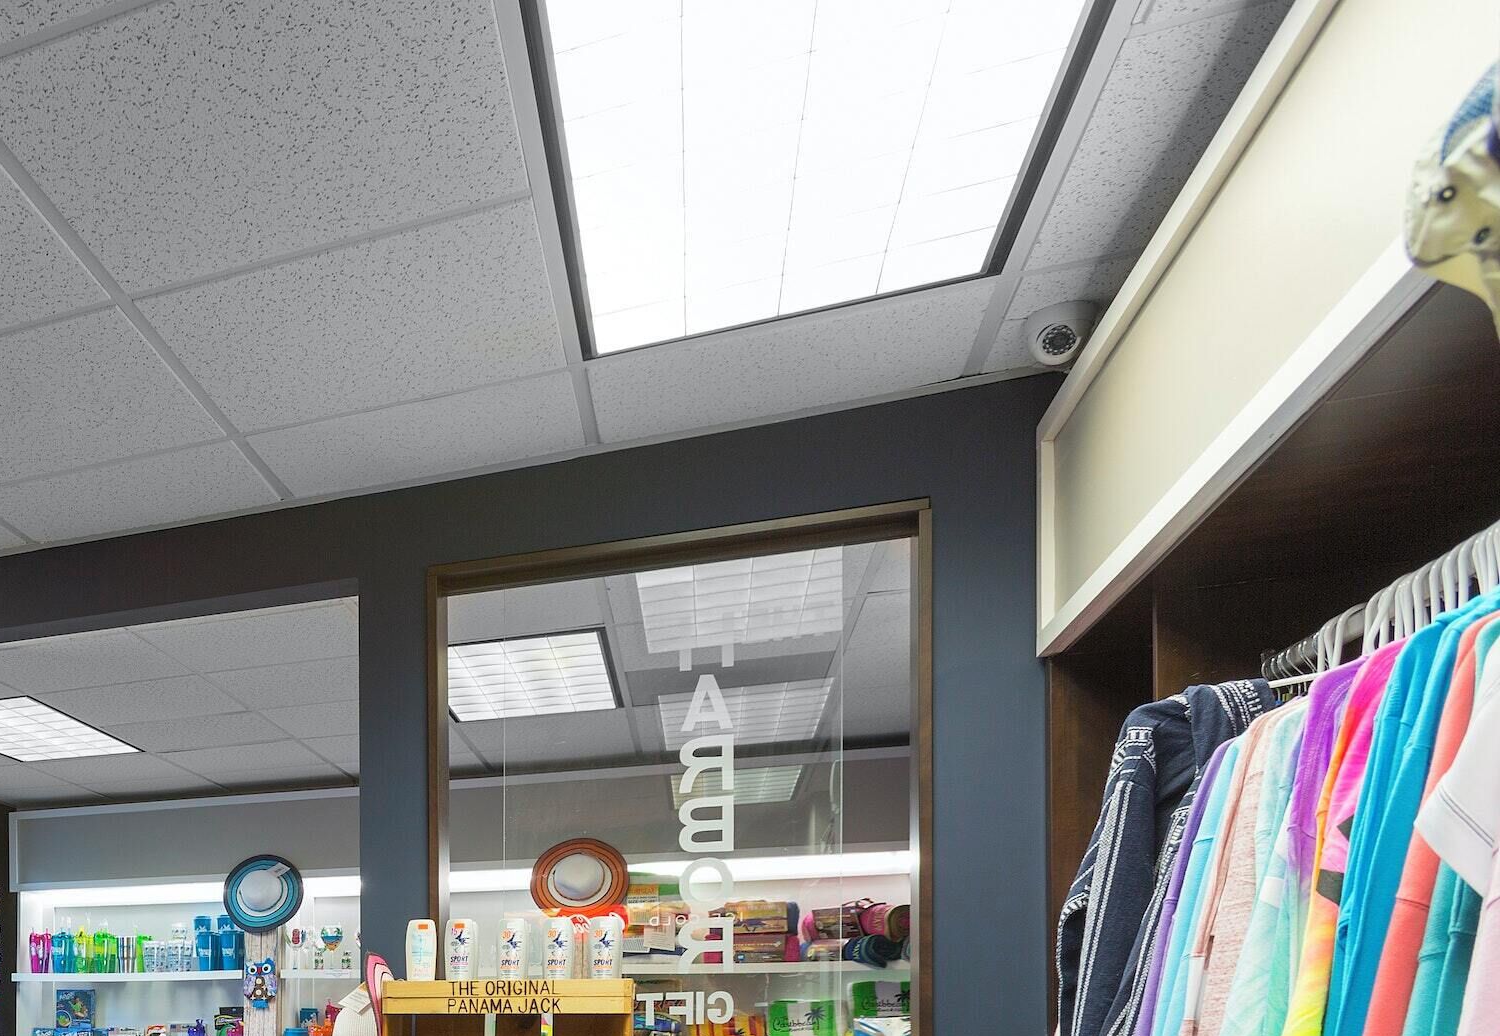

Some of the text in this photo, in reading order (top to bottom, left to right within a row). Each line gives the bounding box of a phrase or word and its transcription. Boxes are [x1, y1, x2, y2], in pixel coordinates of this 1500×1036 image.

[449, 980, 560, 997] THE ORIGINAL
[447, 998, 562, 1014] PANAMA JACK
